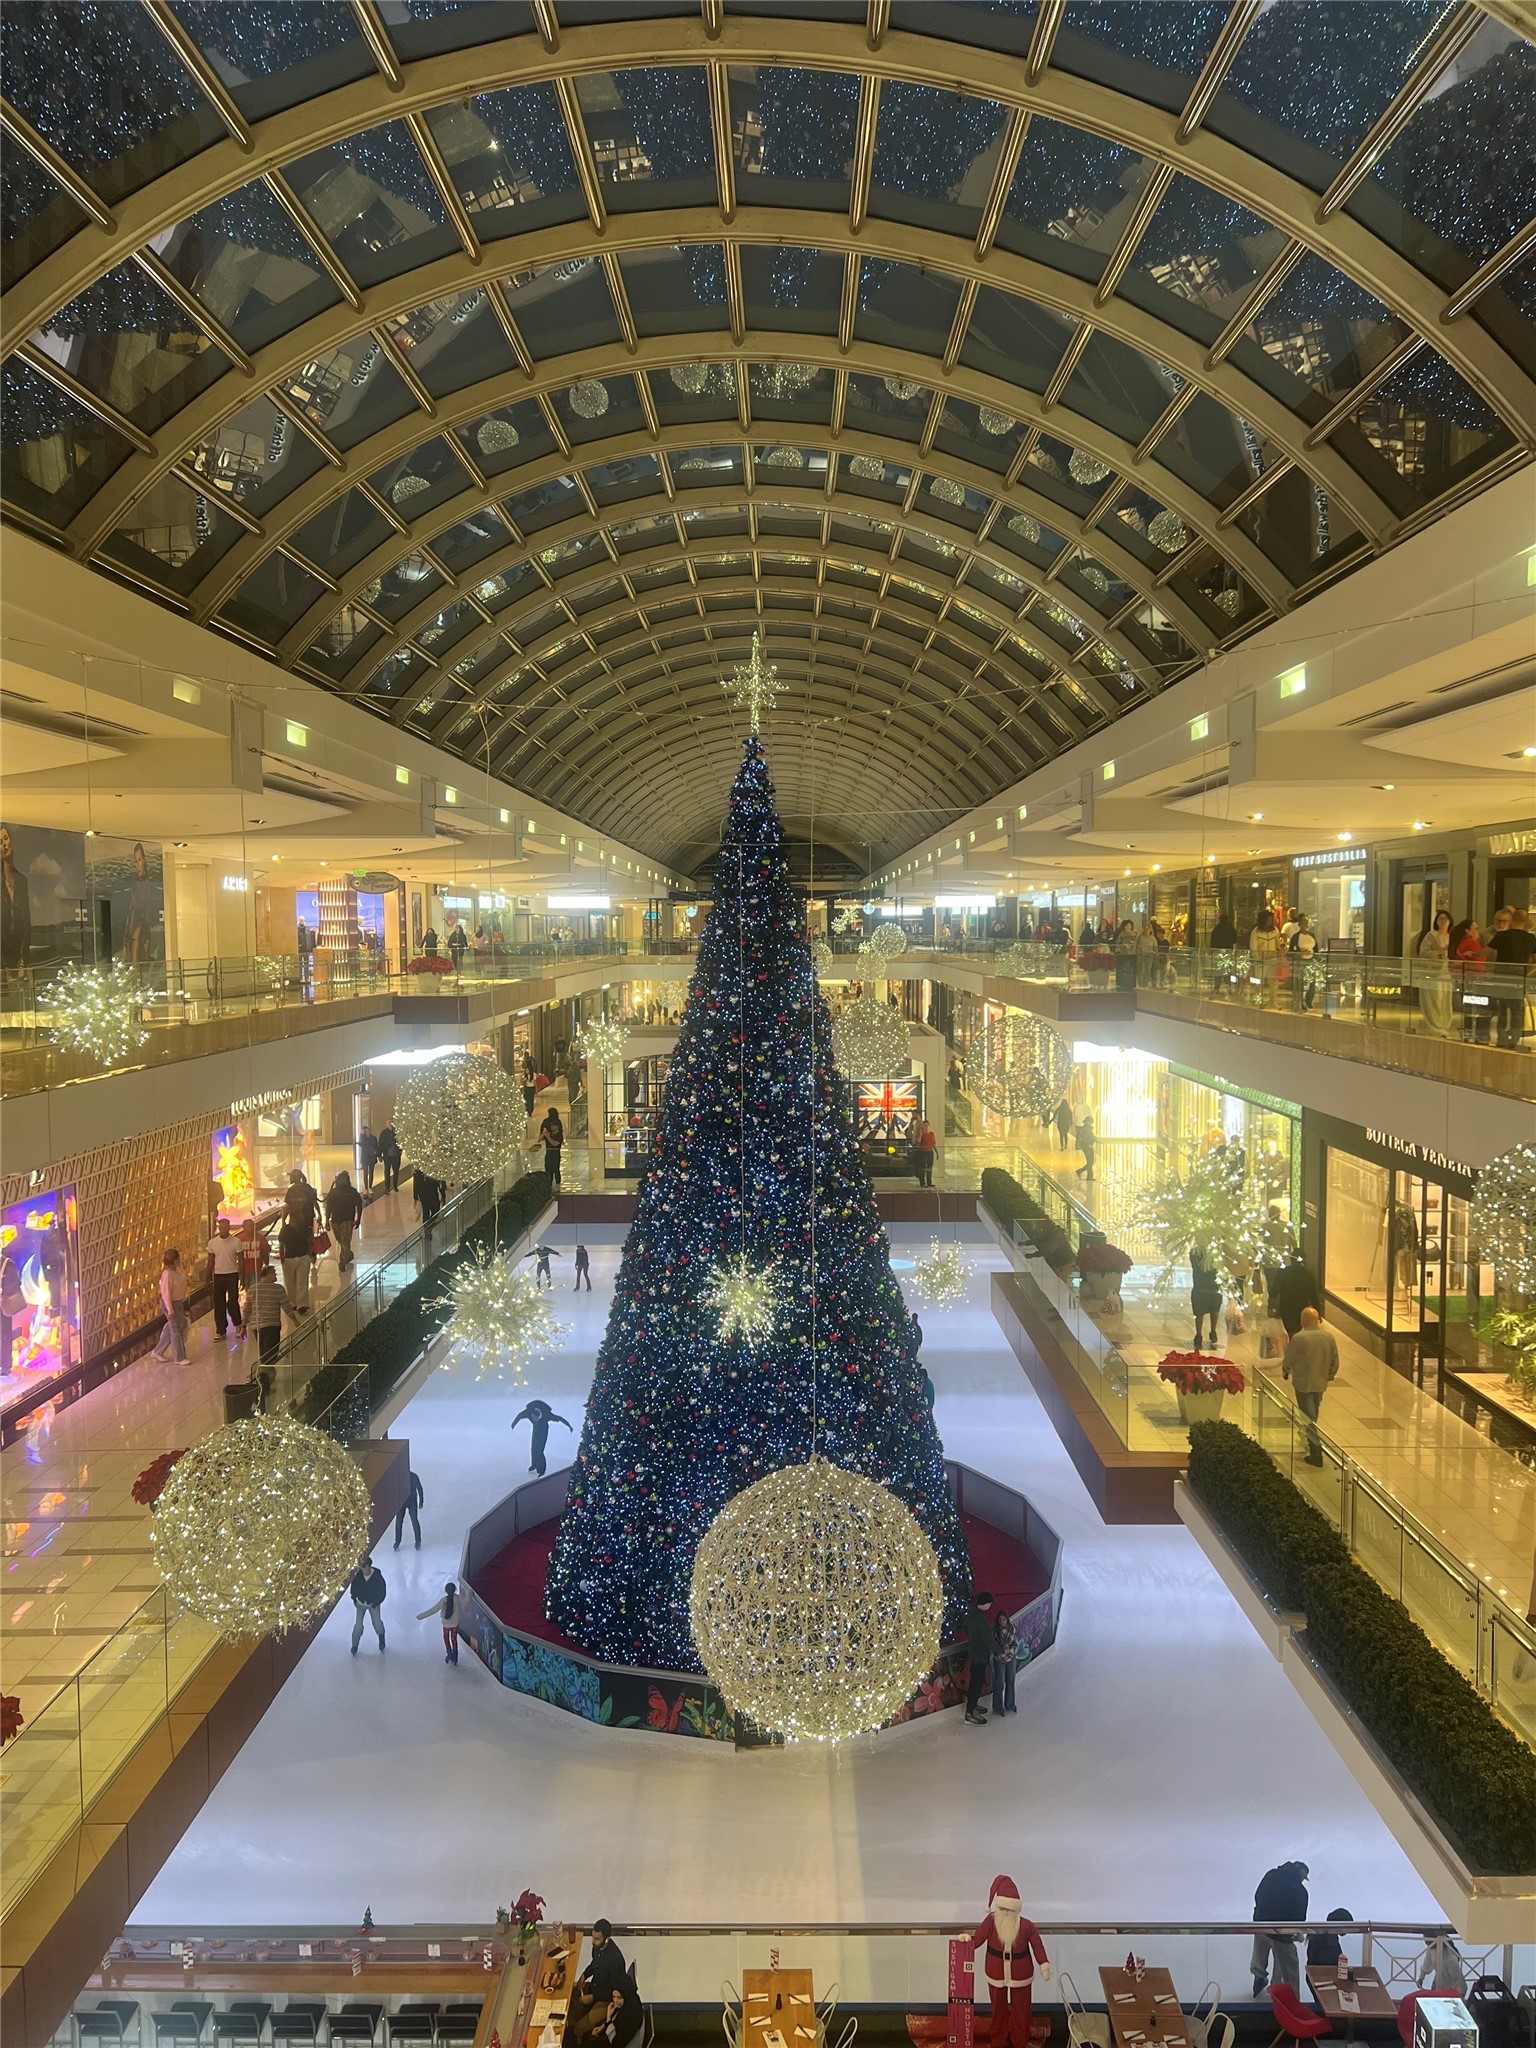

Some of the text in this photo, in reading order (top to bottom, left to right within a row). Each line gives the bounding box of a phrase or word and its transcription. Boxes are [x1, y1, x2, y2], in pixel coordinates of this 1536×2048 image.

[1315, 848, 1367, 865] AUSTRALIA
[1366, 1127, 1472, 1178] BOTTEGA VENETA
